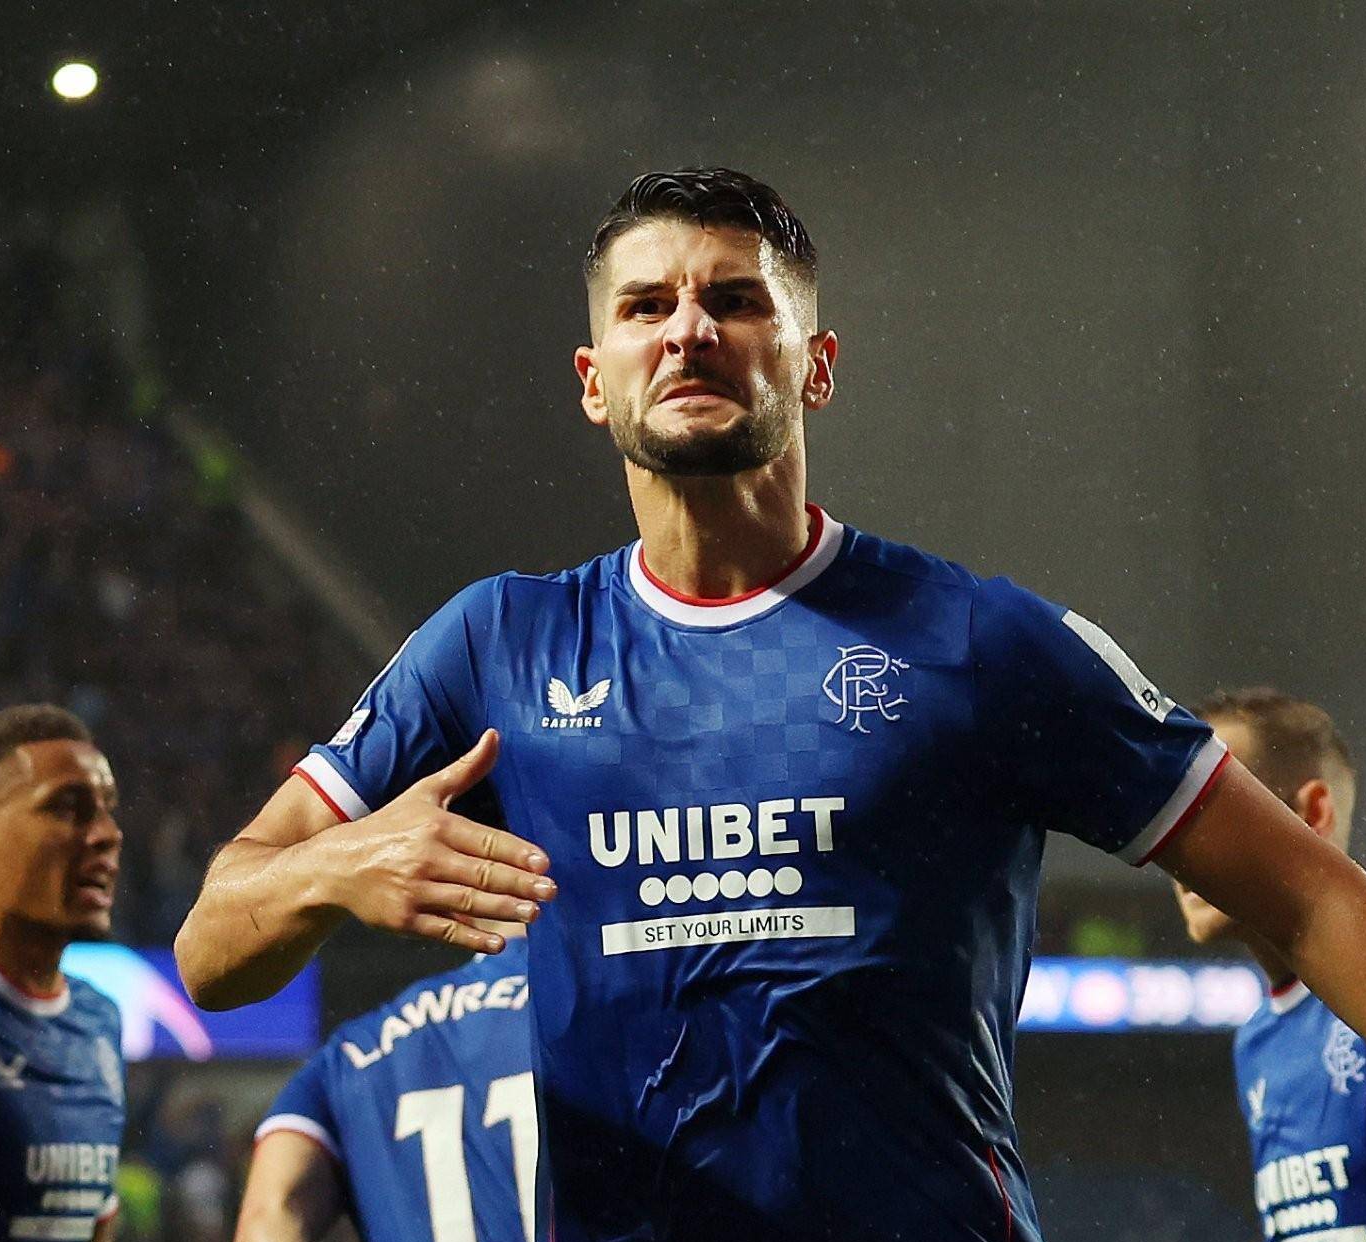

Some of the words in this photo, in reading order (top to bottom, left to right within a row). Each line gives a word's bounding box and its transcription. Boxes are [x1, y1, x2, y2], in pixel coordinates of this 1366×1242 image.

[541, 716, 603, 729] CASTORE
[588, 797, 844, 868] UNIBET
[645, 924, 676, 943] SET
[682, 919, 732, 939] YOUR
[738, 914, 804, 935] LIMITS
[1255, 1144, 1350, 1213] NIBET
